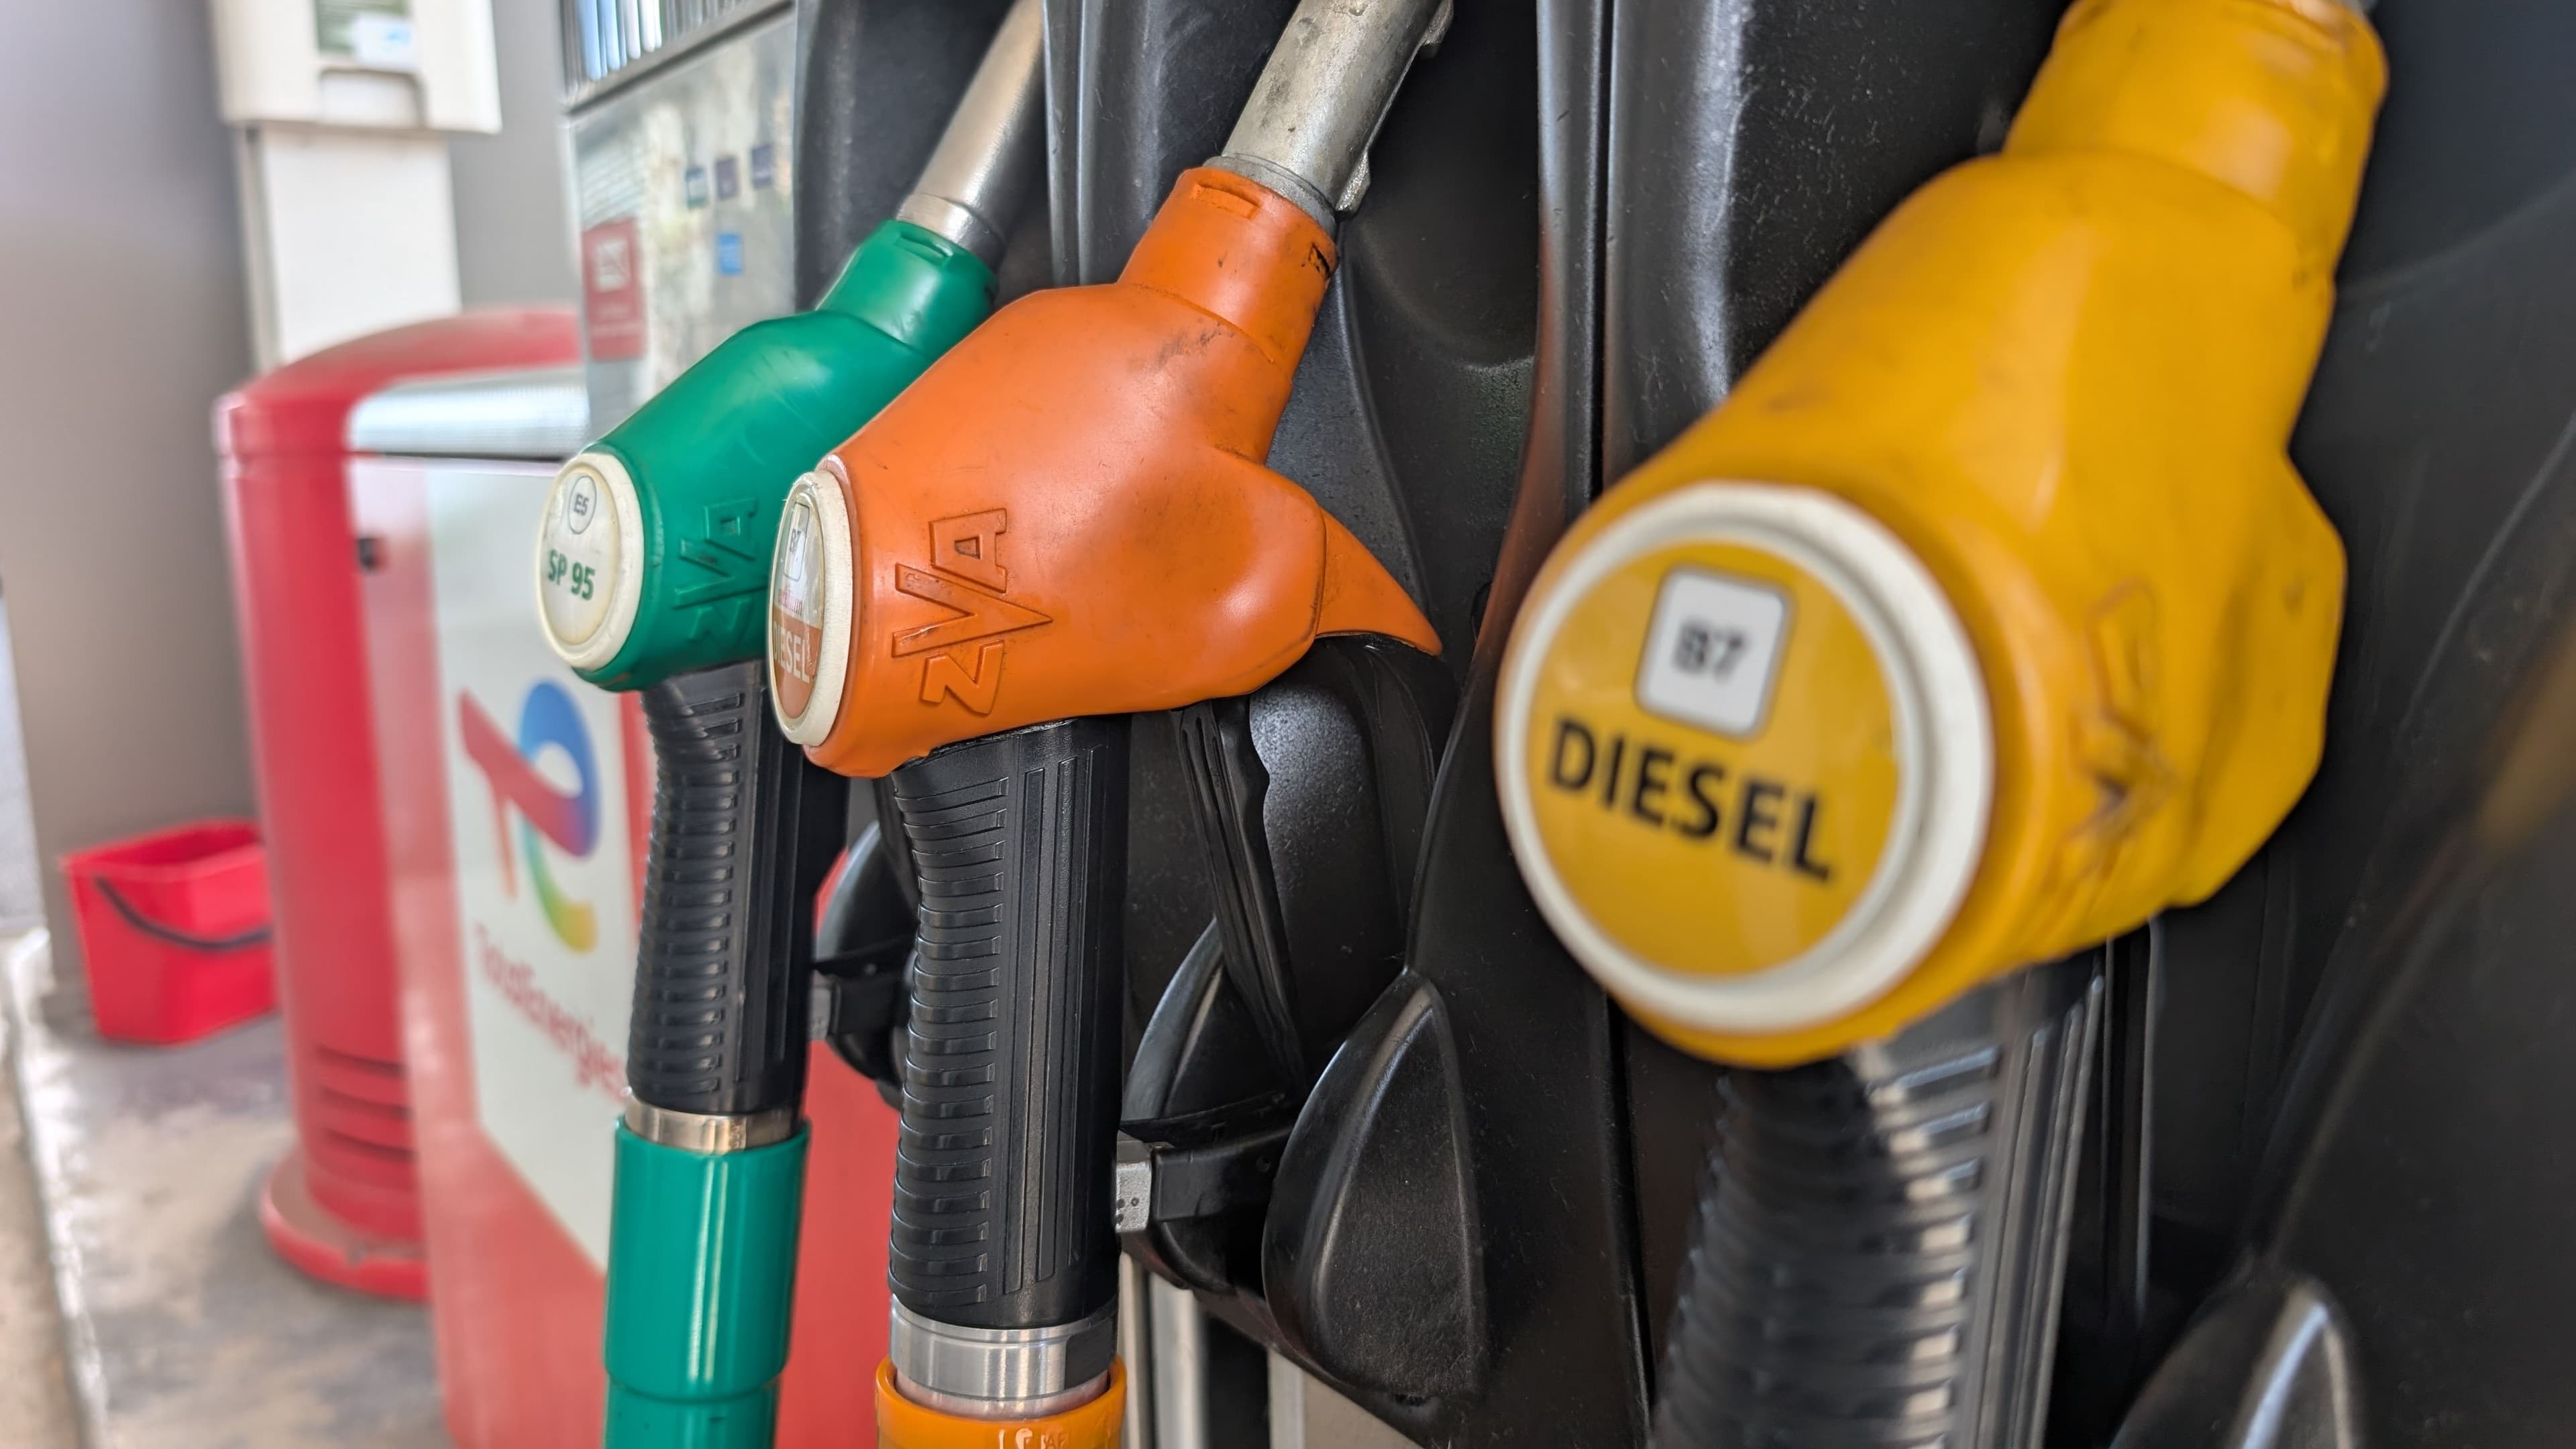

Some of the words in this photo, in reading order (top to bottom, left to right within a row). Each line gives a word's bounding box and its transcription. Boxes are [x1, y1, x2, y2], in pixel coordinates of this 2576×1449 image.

[574, 493, 589, 516] E5
[548, 549, 568, 586] SP
[571, 561, 596, 601] 95
[892, 508, 1053, 716] ZVA
[772, 620, 810, 684] DIESEL
[1673, 620, 1746, 680] B7
[1551, 716, 1834, 883] DIESEL
